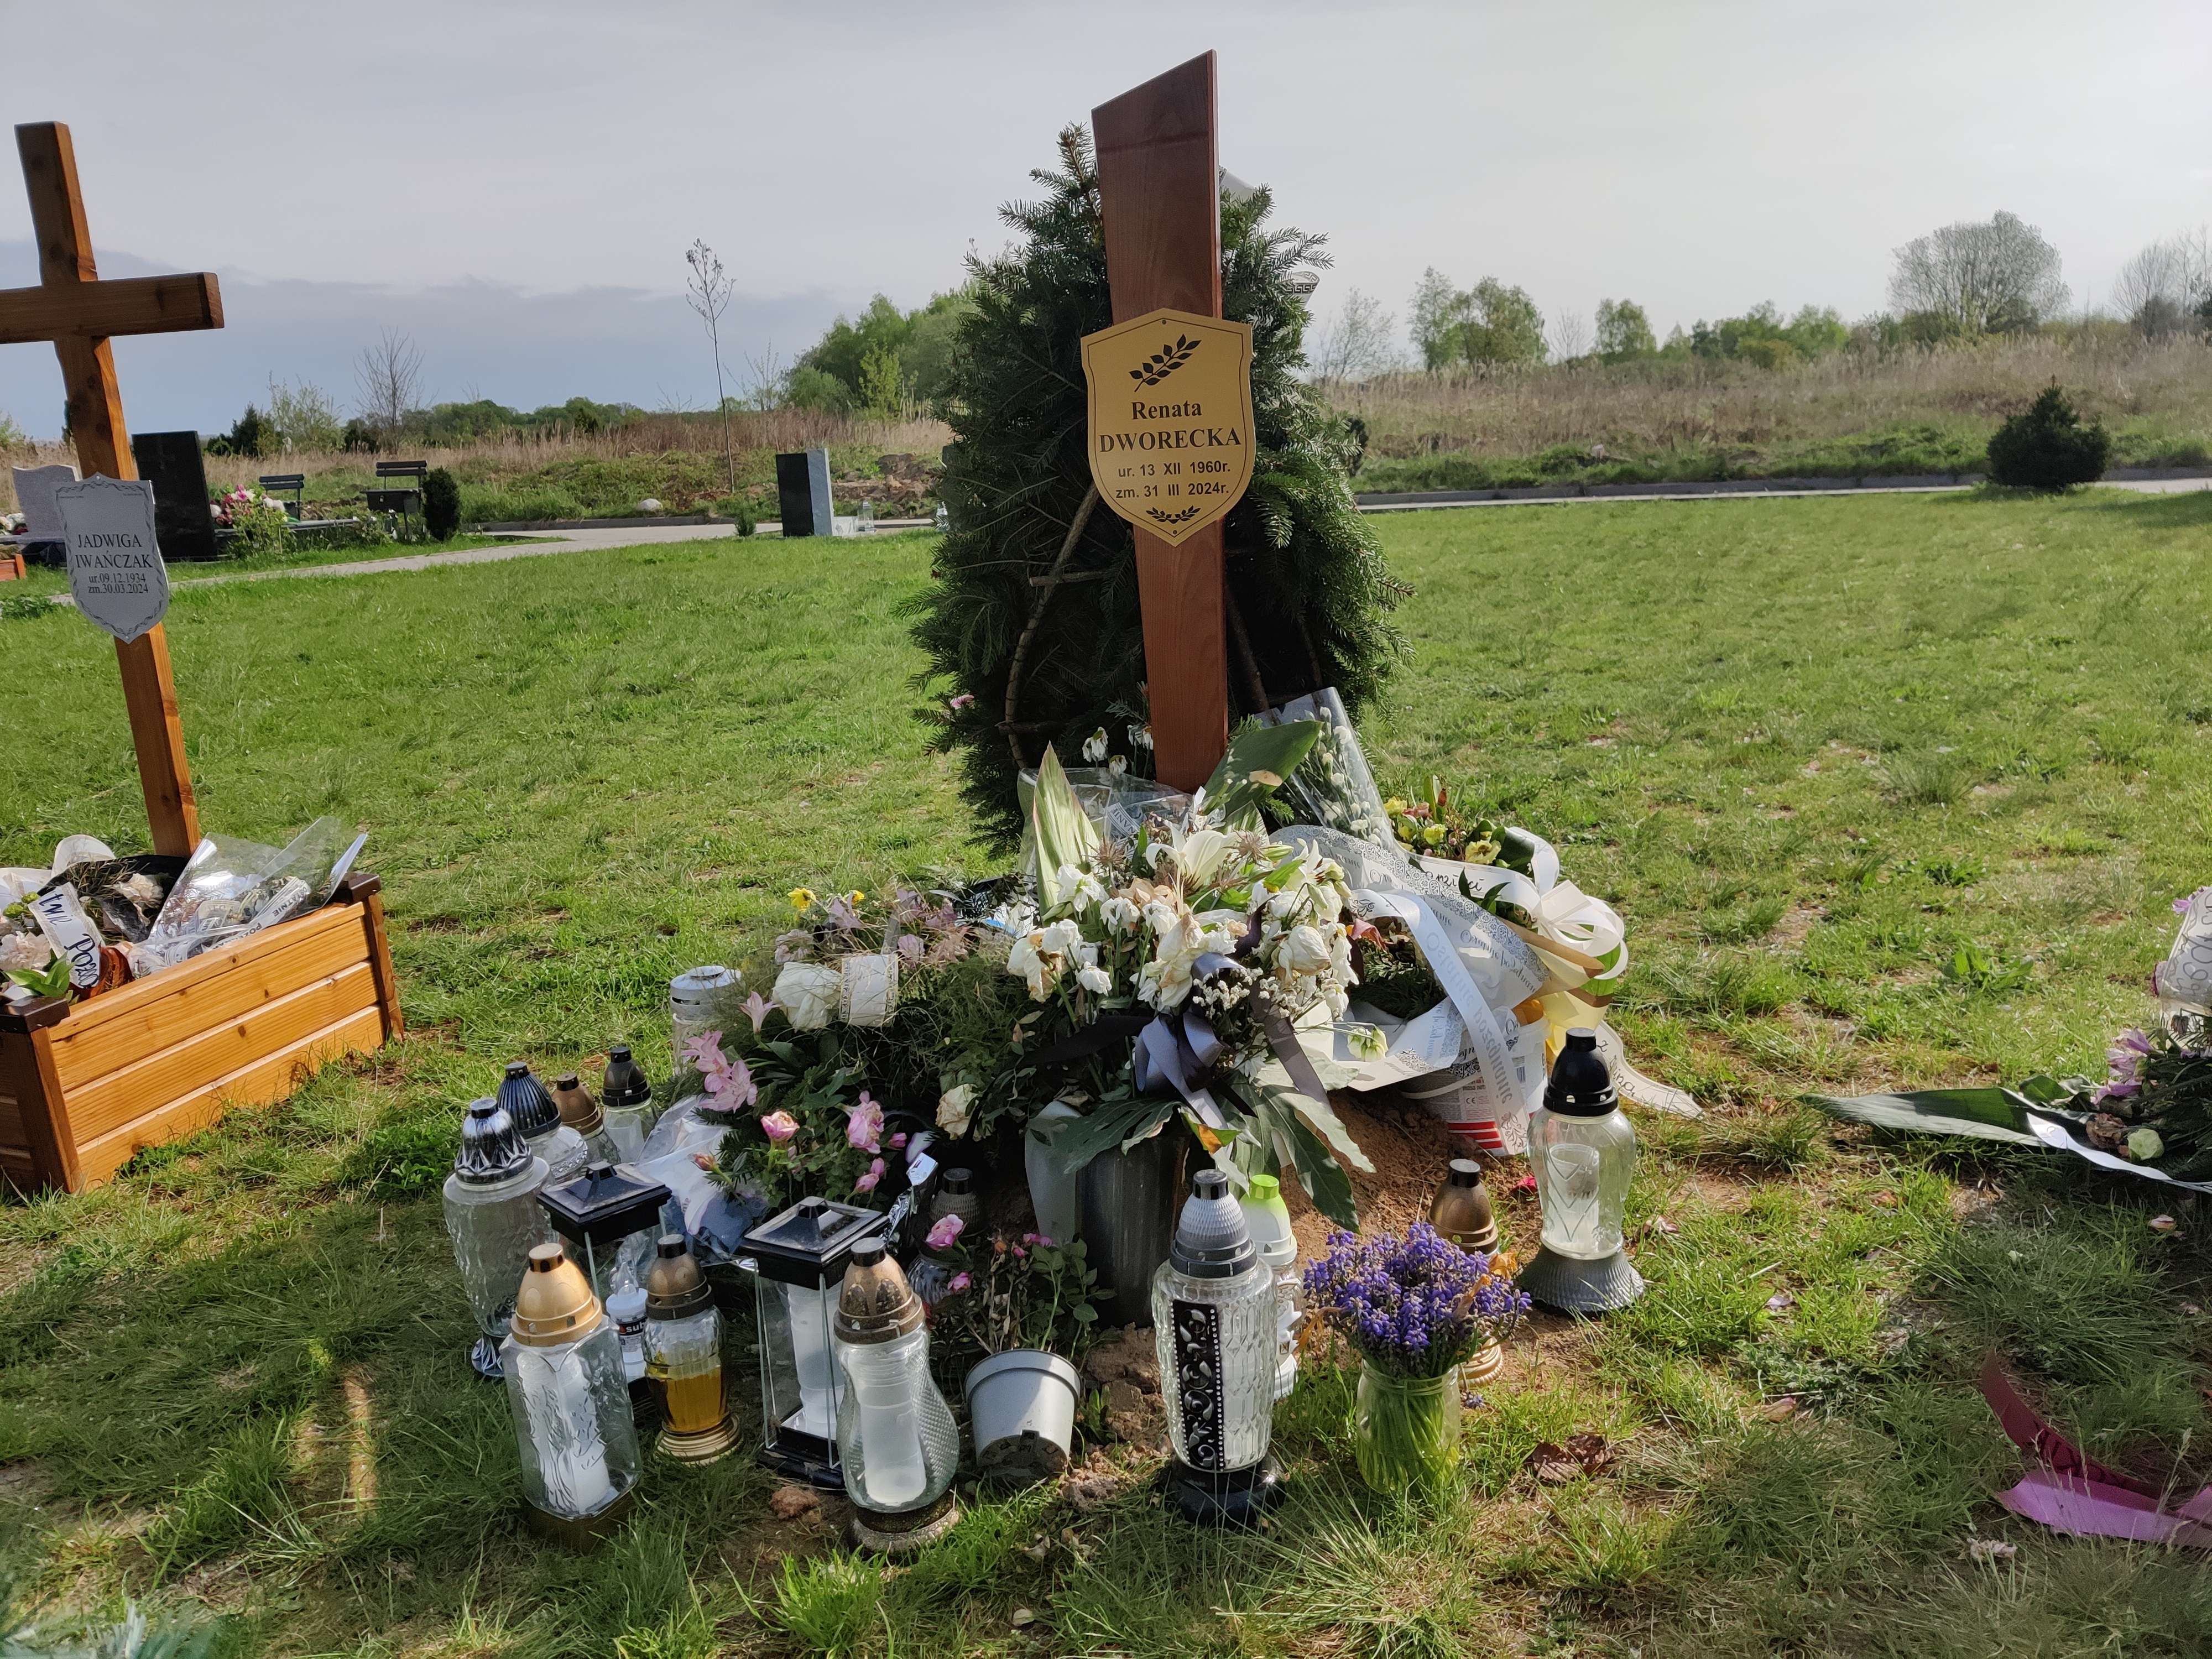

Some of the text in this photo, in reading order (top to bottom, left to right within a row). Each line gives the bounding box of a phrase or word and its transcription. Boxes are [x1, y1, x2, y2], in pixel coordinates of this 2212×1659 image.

[1131, 400, 1202, 420] Renata
[1099, 427, 1241, 452] DWORECKA
[1118, 460, 1230, 477] ur. 13 XII 1960r.
[1116, 482, 1229, 498] zm. 31 III 2024r.
[78, 534, 142, 549] JADWIGA
[75, 550, 153, 568] IWAŃCZAK
[88, 573, 146, 583] ur.09.12.1934
[88, 583, 148, 594] zm.30.03.2024
